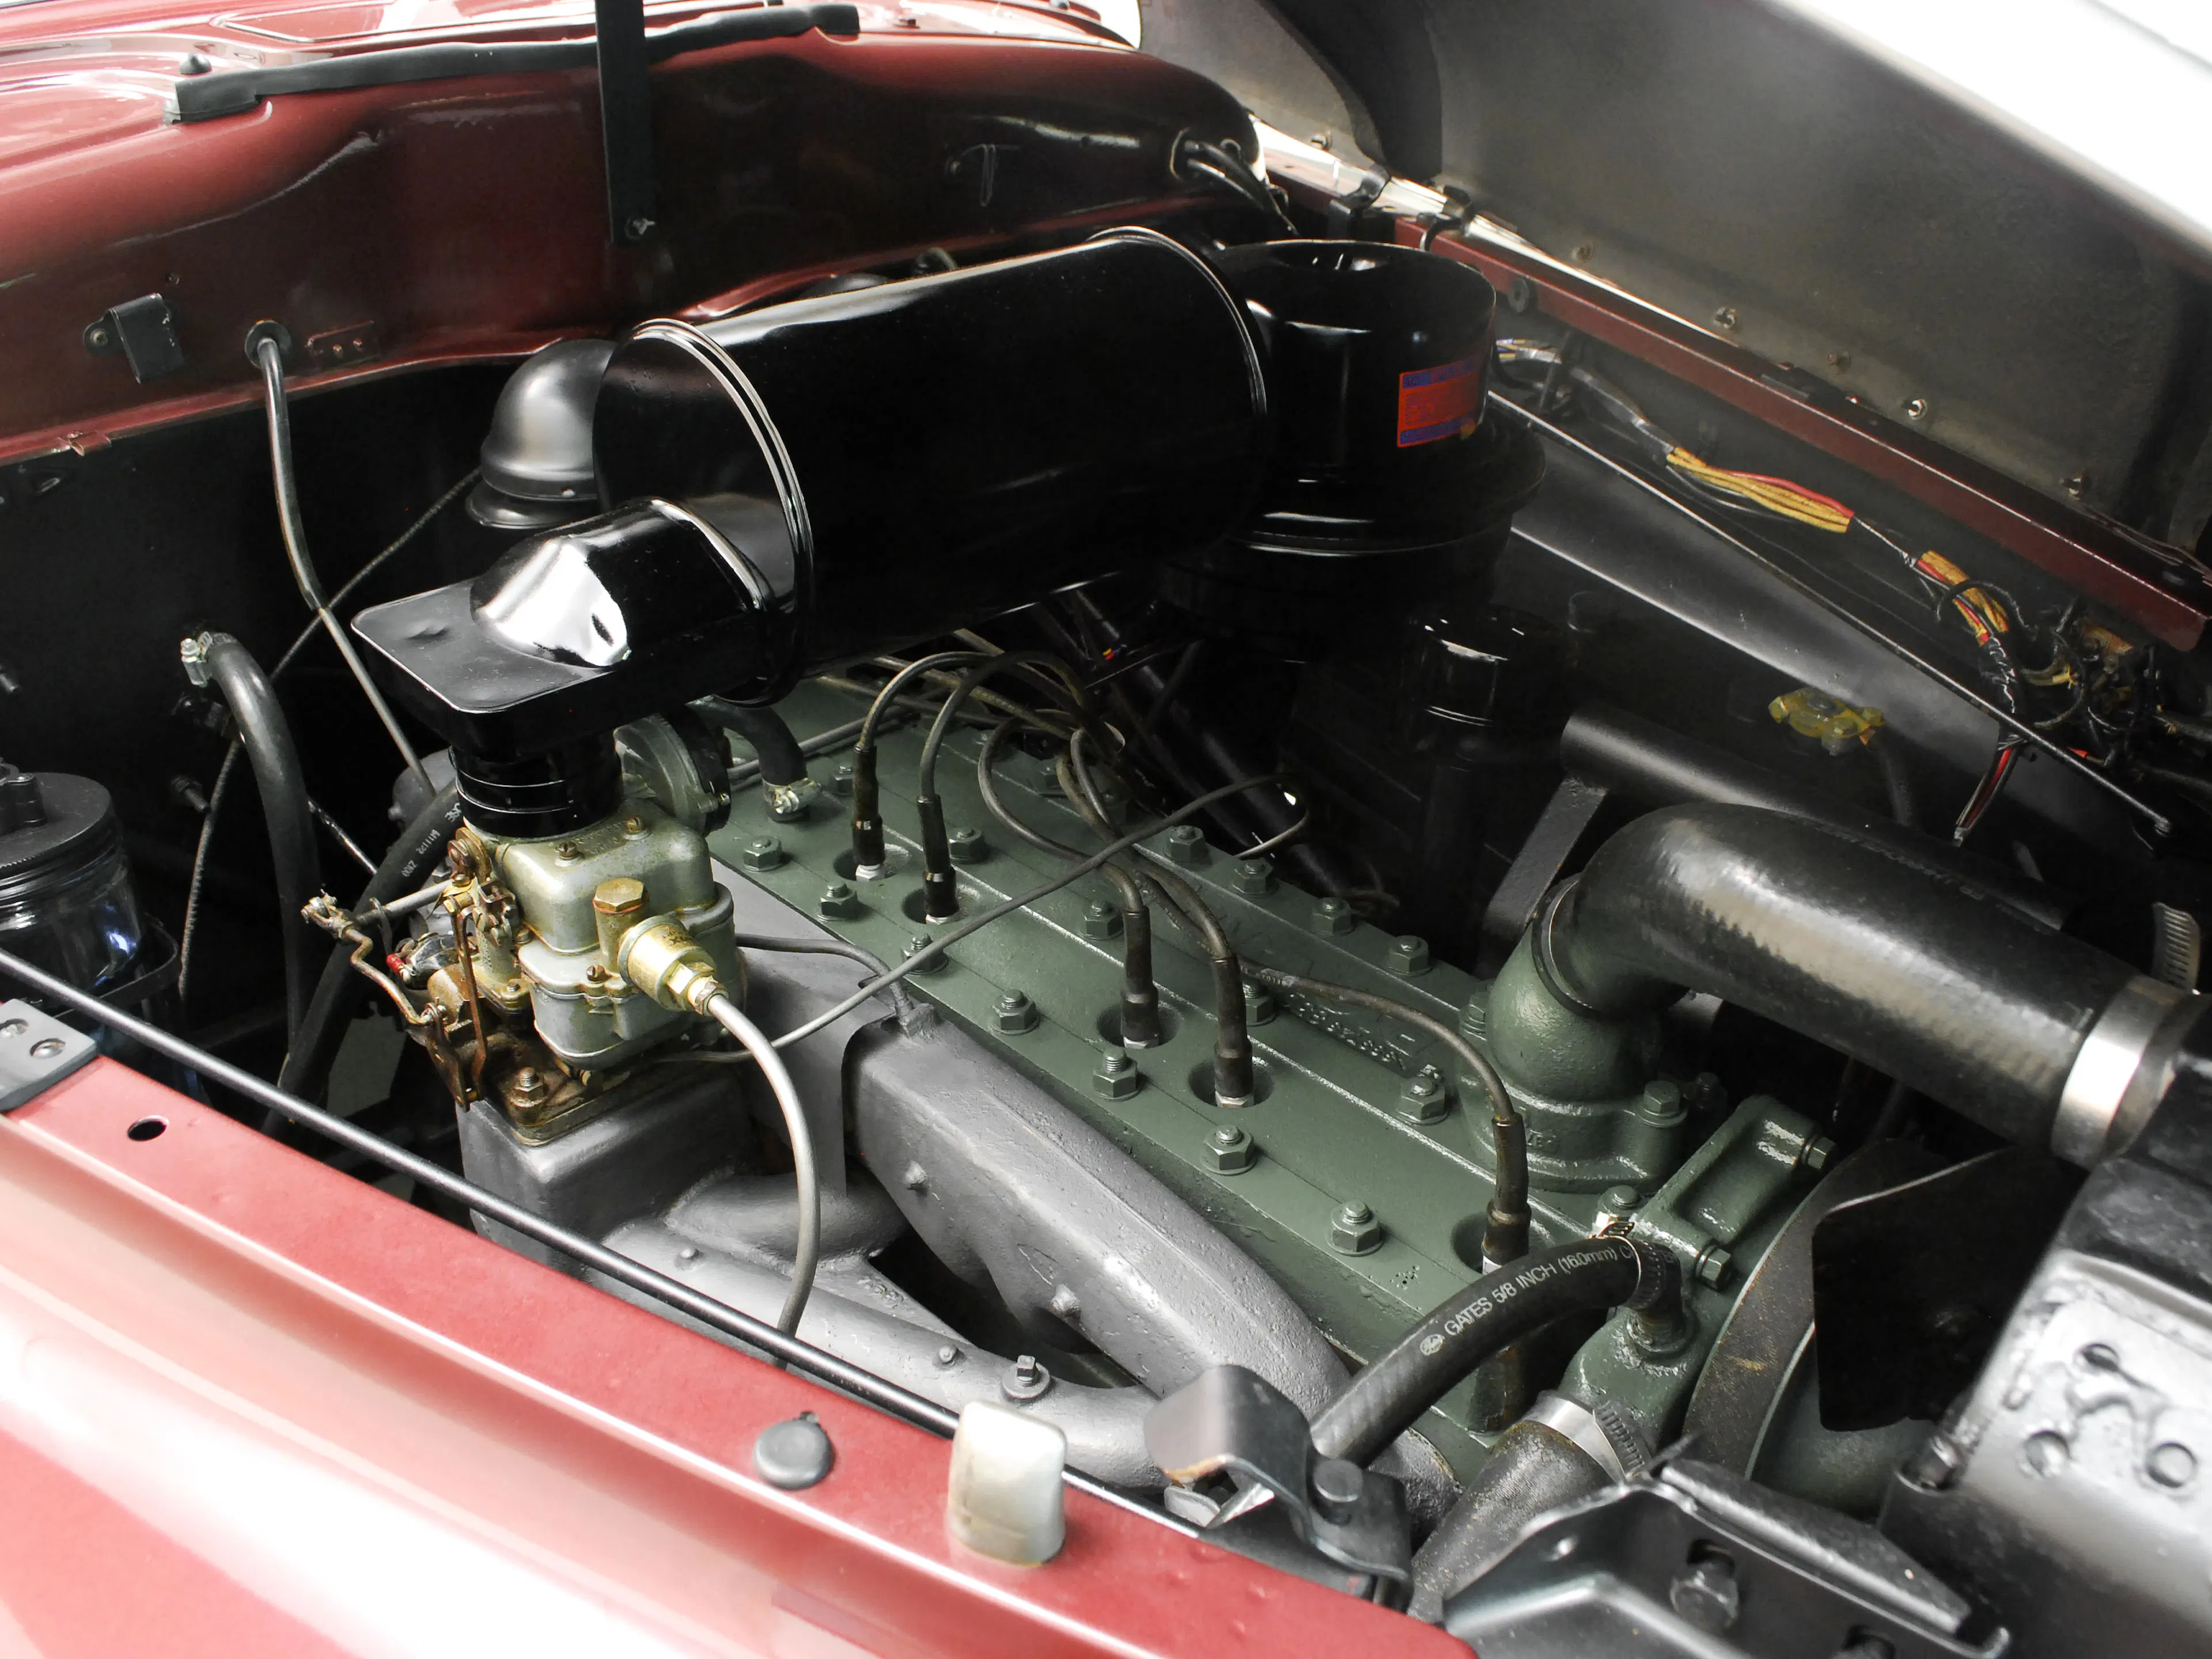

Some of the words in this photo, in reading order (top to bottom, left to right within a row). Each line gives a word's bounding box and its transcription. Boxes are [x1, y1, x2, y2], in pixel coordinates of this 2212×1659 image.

[1444, 1297, 1493, 1336] GATES
[1491, 1282, 1517, 1303] 5/8
[1515, 1263, 1558, 1289] INCH
